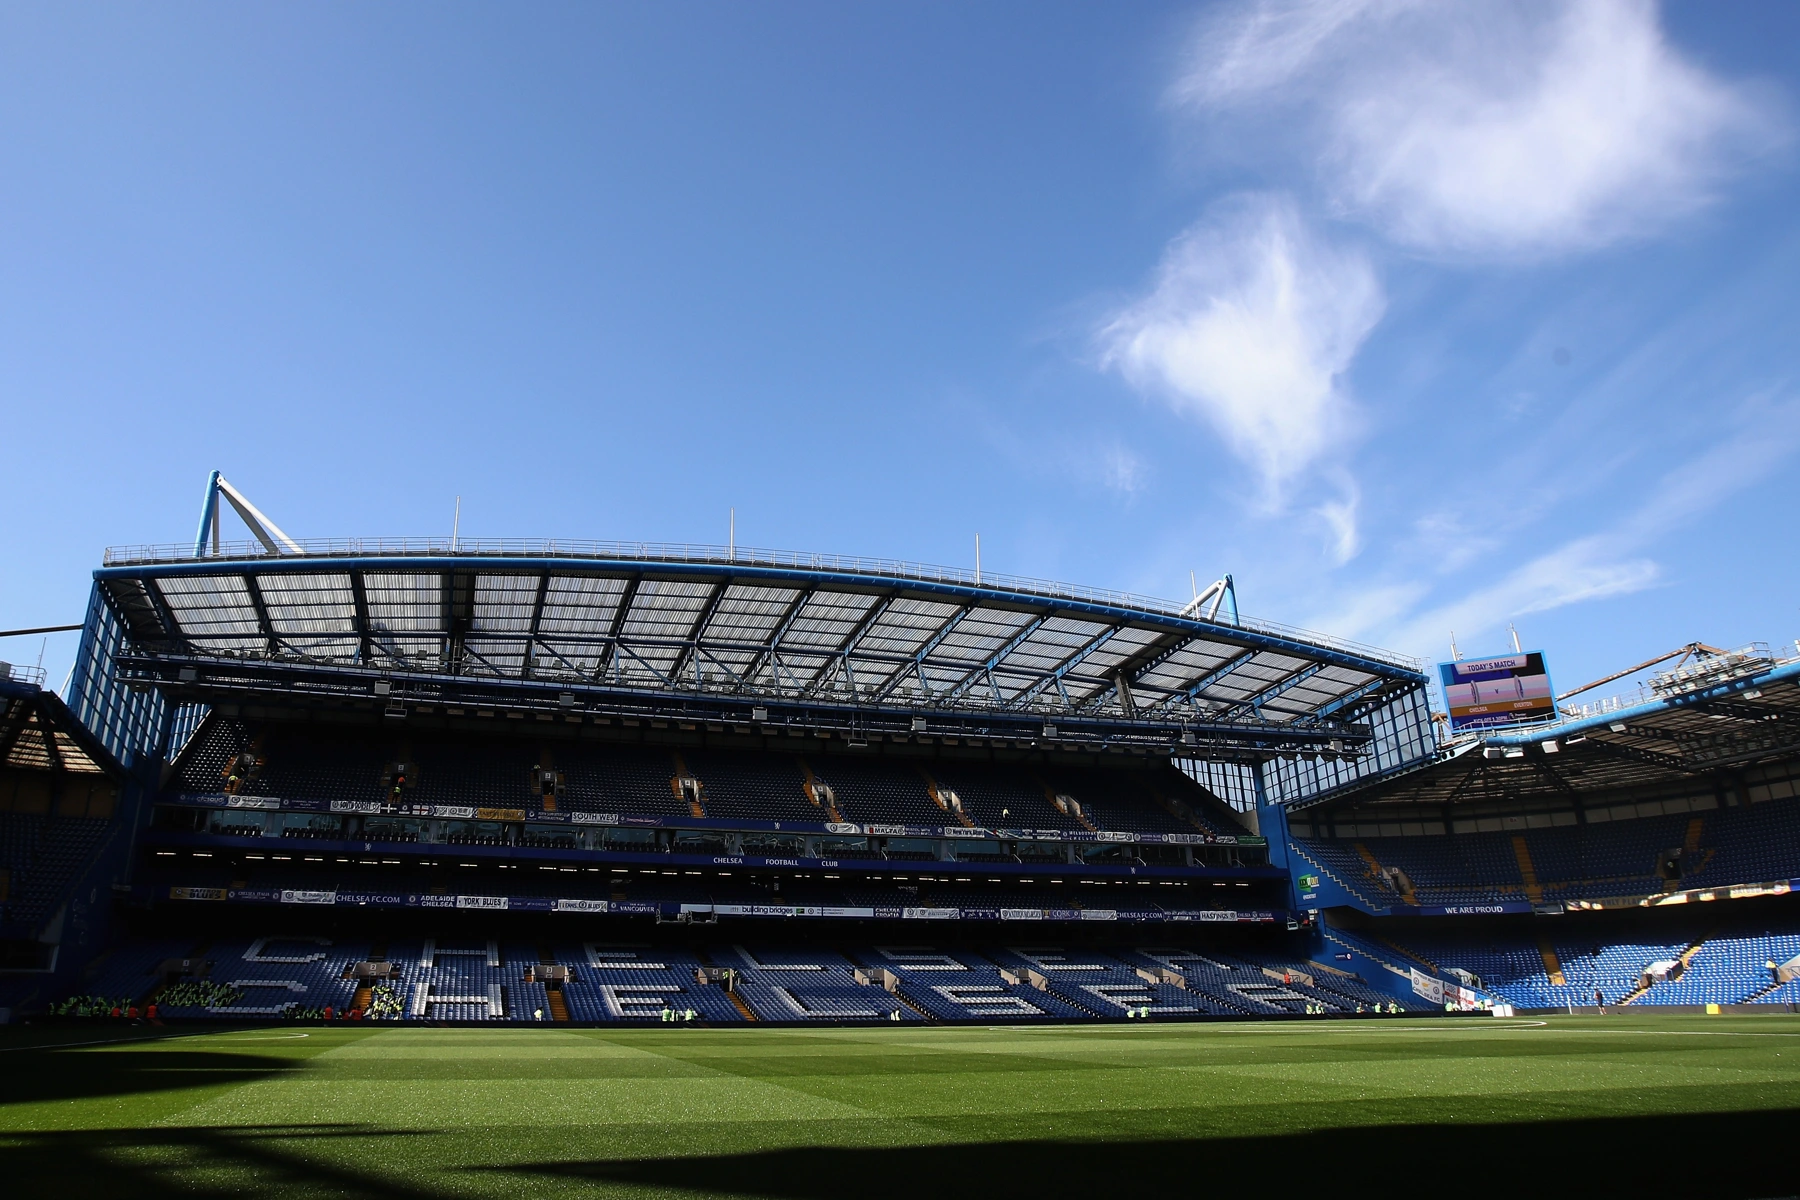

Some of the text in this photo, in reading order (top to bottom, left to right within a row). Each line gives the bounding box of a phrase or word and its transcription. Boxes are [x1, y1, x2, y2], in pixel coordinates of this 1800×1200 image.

[1468, 660, 1516, 672] TODAY'S MATCH
[573, 812, 597, 820] SOUTH
[713, 857, 743, 865] CHELSEA
[765, 858, 799, 866] FOOTBALL
[464, 898, 480, 906] YORK
[483, 898, 501, 907] BLUES
[742, 906, 793, 915] buding bridges
[1459, 906, 1475, 914] ARE
[1476, 905, 1503, 914] PROUD
[1412, 986, 1433, 1000] CHELSEA
